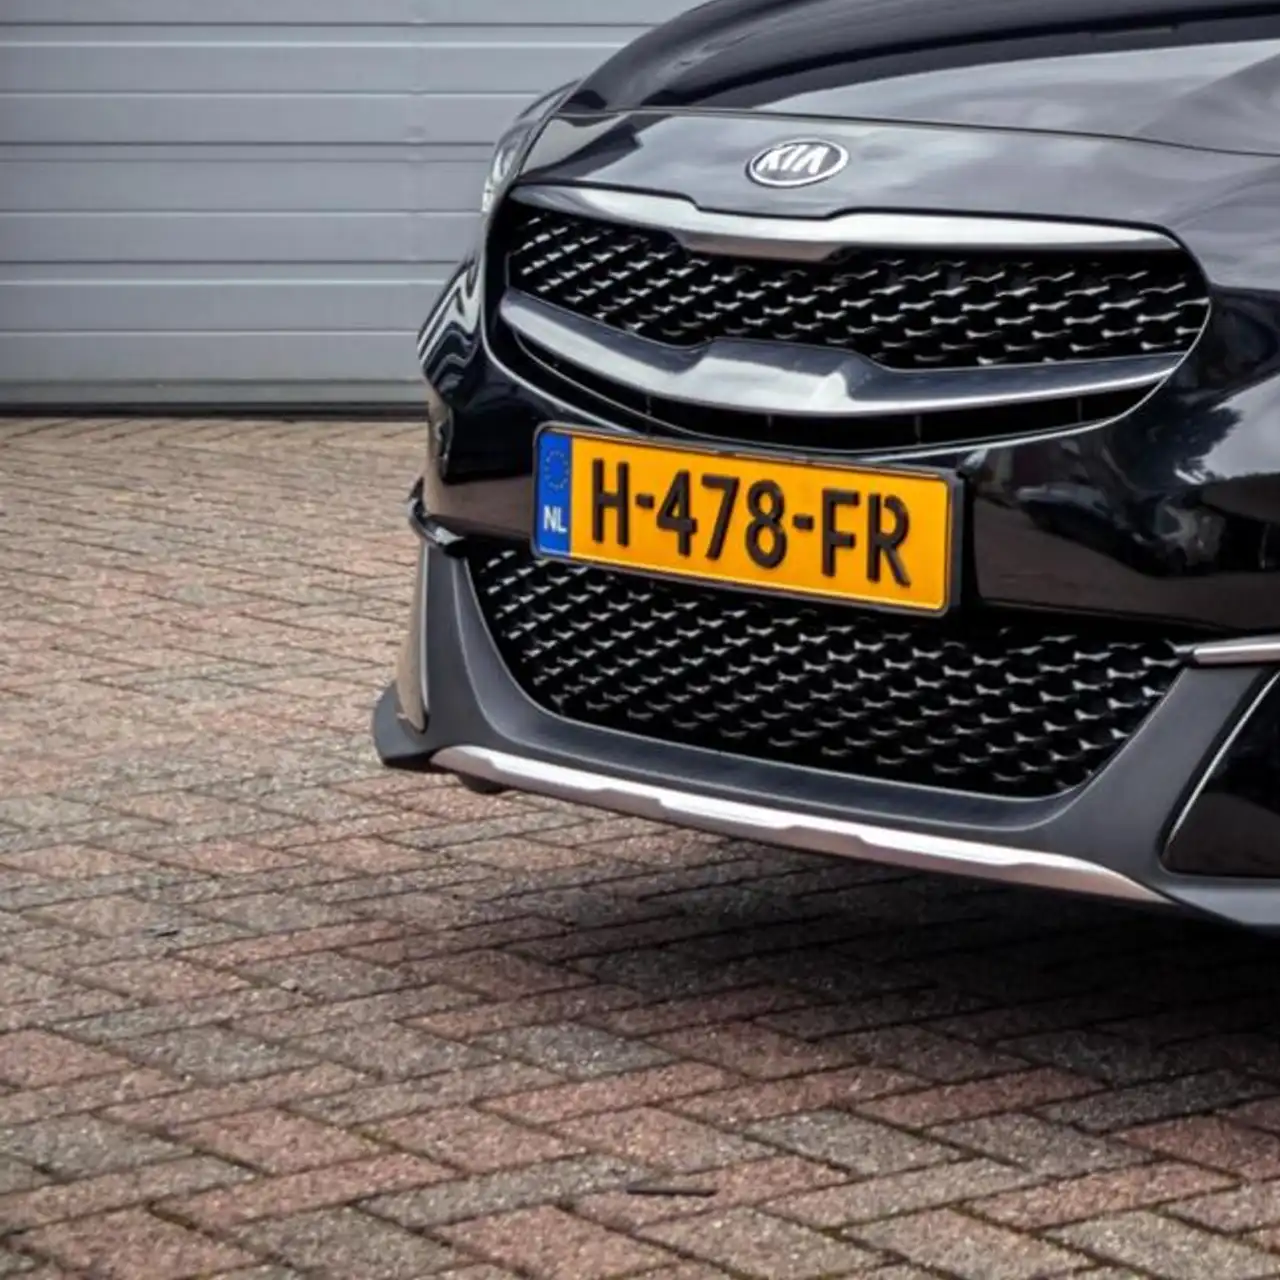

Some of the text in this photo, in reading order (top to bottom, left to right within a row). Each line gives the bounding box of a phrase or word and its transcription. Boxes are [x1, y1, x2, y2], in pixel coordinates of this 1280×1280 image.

[755, 143, 830, 175] KIA
[543, 504, 567, 533] NL
[591, 458, 911, 588] H-478-FR
